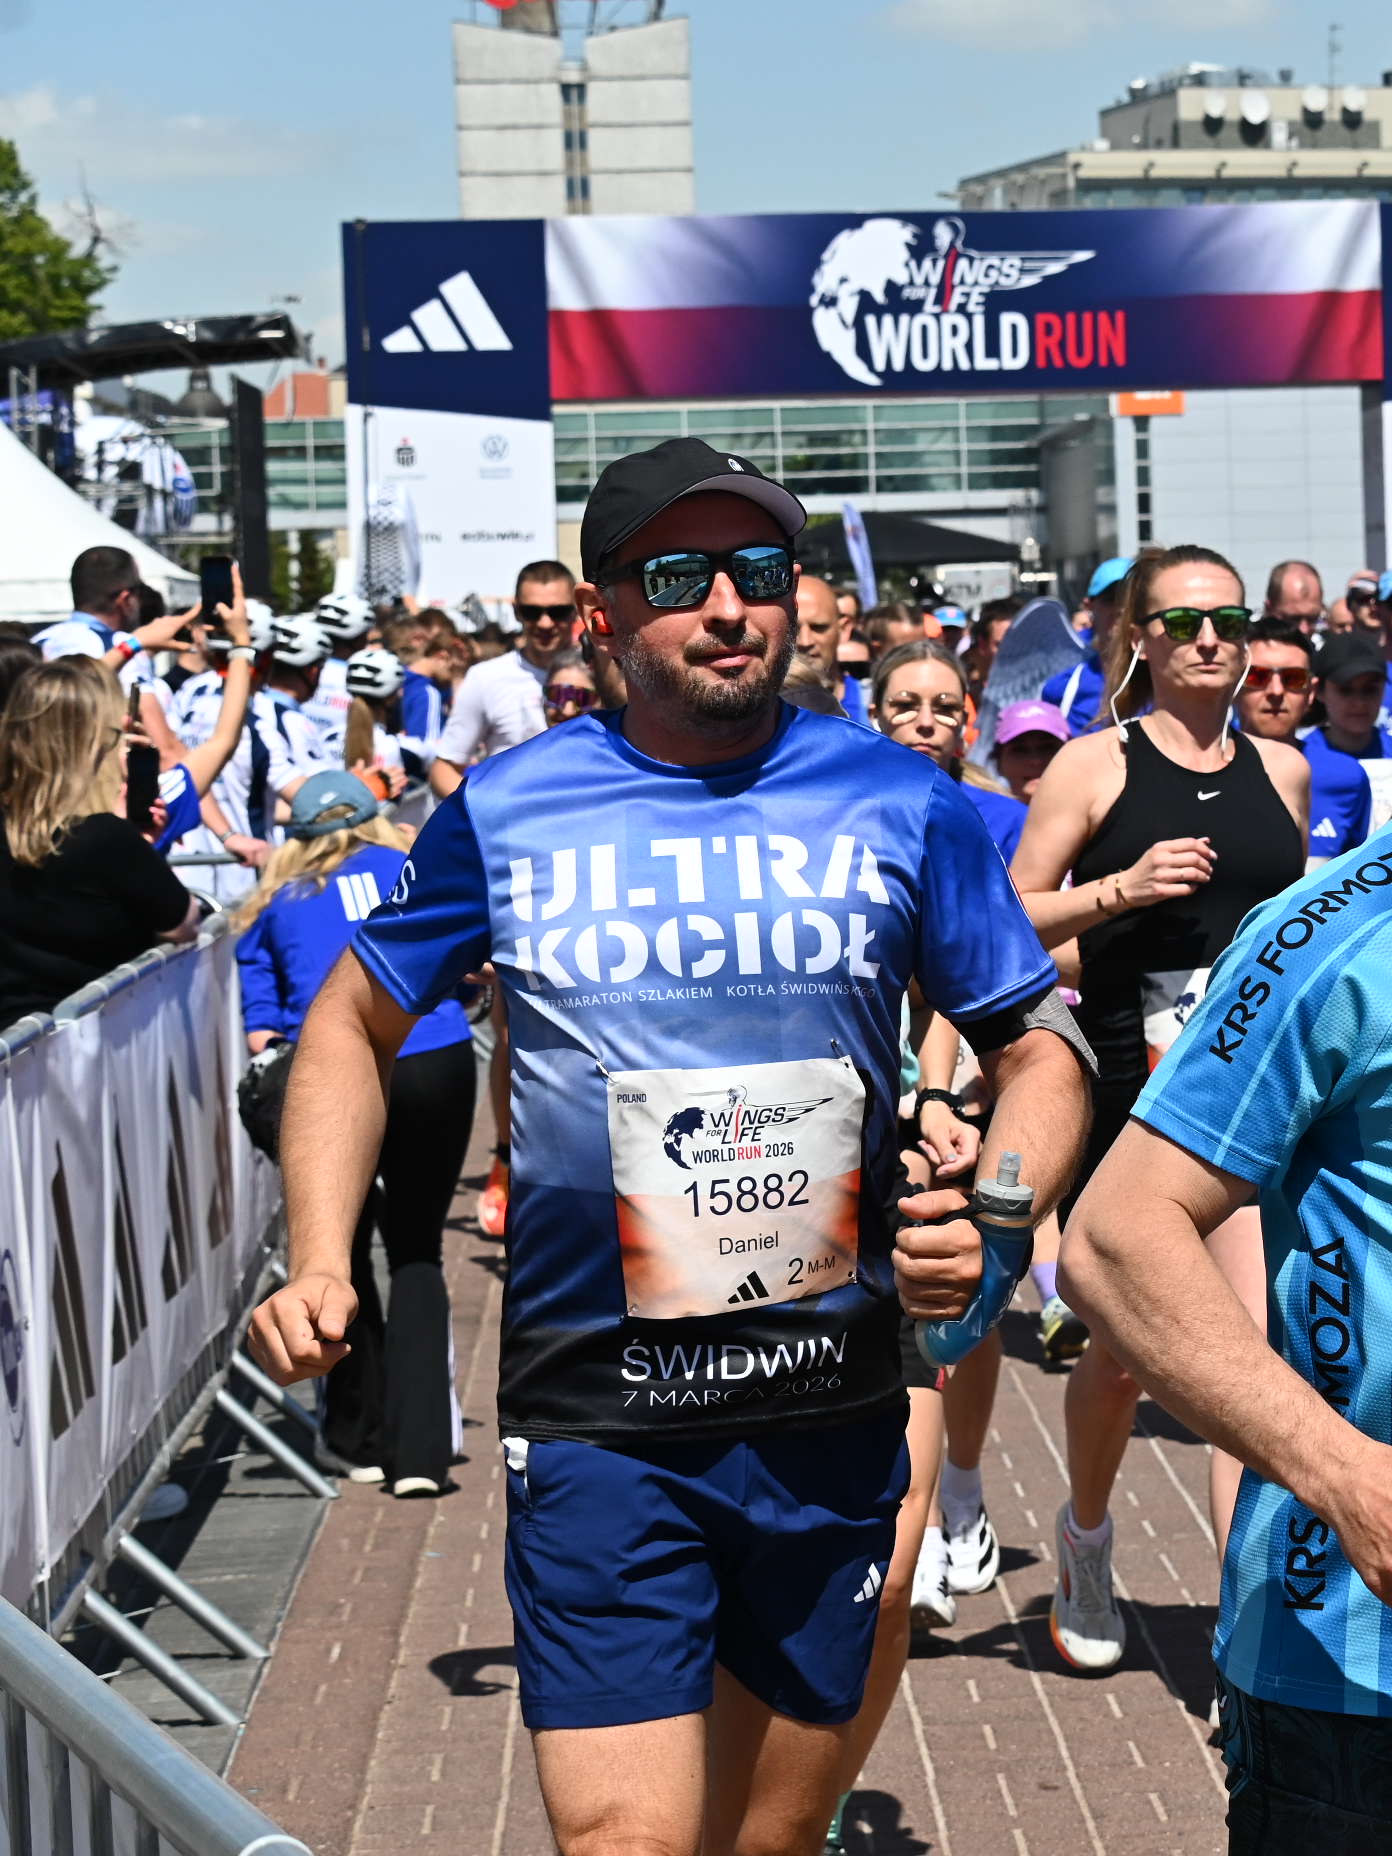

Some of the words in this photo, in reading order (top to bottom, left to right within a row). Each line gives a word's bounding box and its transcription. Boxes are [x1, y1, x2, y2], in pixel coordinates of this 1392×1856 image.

[907, 250, 1023, 287] WINGS
[922, 285, 991, 313] LIFE
[864, 310, 1030, 372] WORLD
[1034, 310, 1127, 369] RUN
[509, 834, 891, 922] ULTRA
[513, 908, 881, 991] KOCIOŁ
[638, 986, 713, 1001] SZLAKIEM
[726, 984, 776, 998] KOTŁA
[1208, 975, 1272, 1064] KRS
[616, 1093, 648, 1104] POLAND
[709, 1105, 787, 1129] WINGS
[692, 1147, 736, 1165] WORLD
[737, 1145, 762, 1160] RUN
[765, 1141, 795, 1159] 2026
[706, 1129, 722, 1138] FOR
[720, 1125, 764, 1146] LIFE
[683, 1169, 810, 1218] 15882
[718, 1231, 780, 1256] Daniel
[787, 1257, 804, 1286] 2
[807, 1255, 836, 1275] M-M
[1309, 1236, 1352, 1420] MOZA
[620, 1331, 848, 1382] ŚWIDWIN
[620, 1390, 639, 1408] 7
[650, 1386, 766, 1407] MARCA
[775, 1373, 842, 1398] 2026
[1284, 1516, 1330, 1612] KRS
